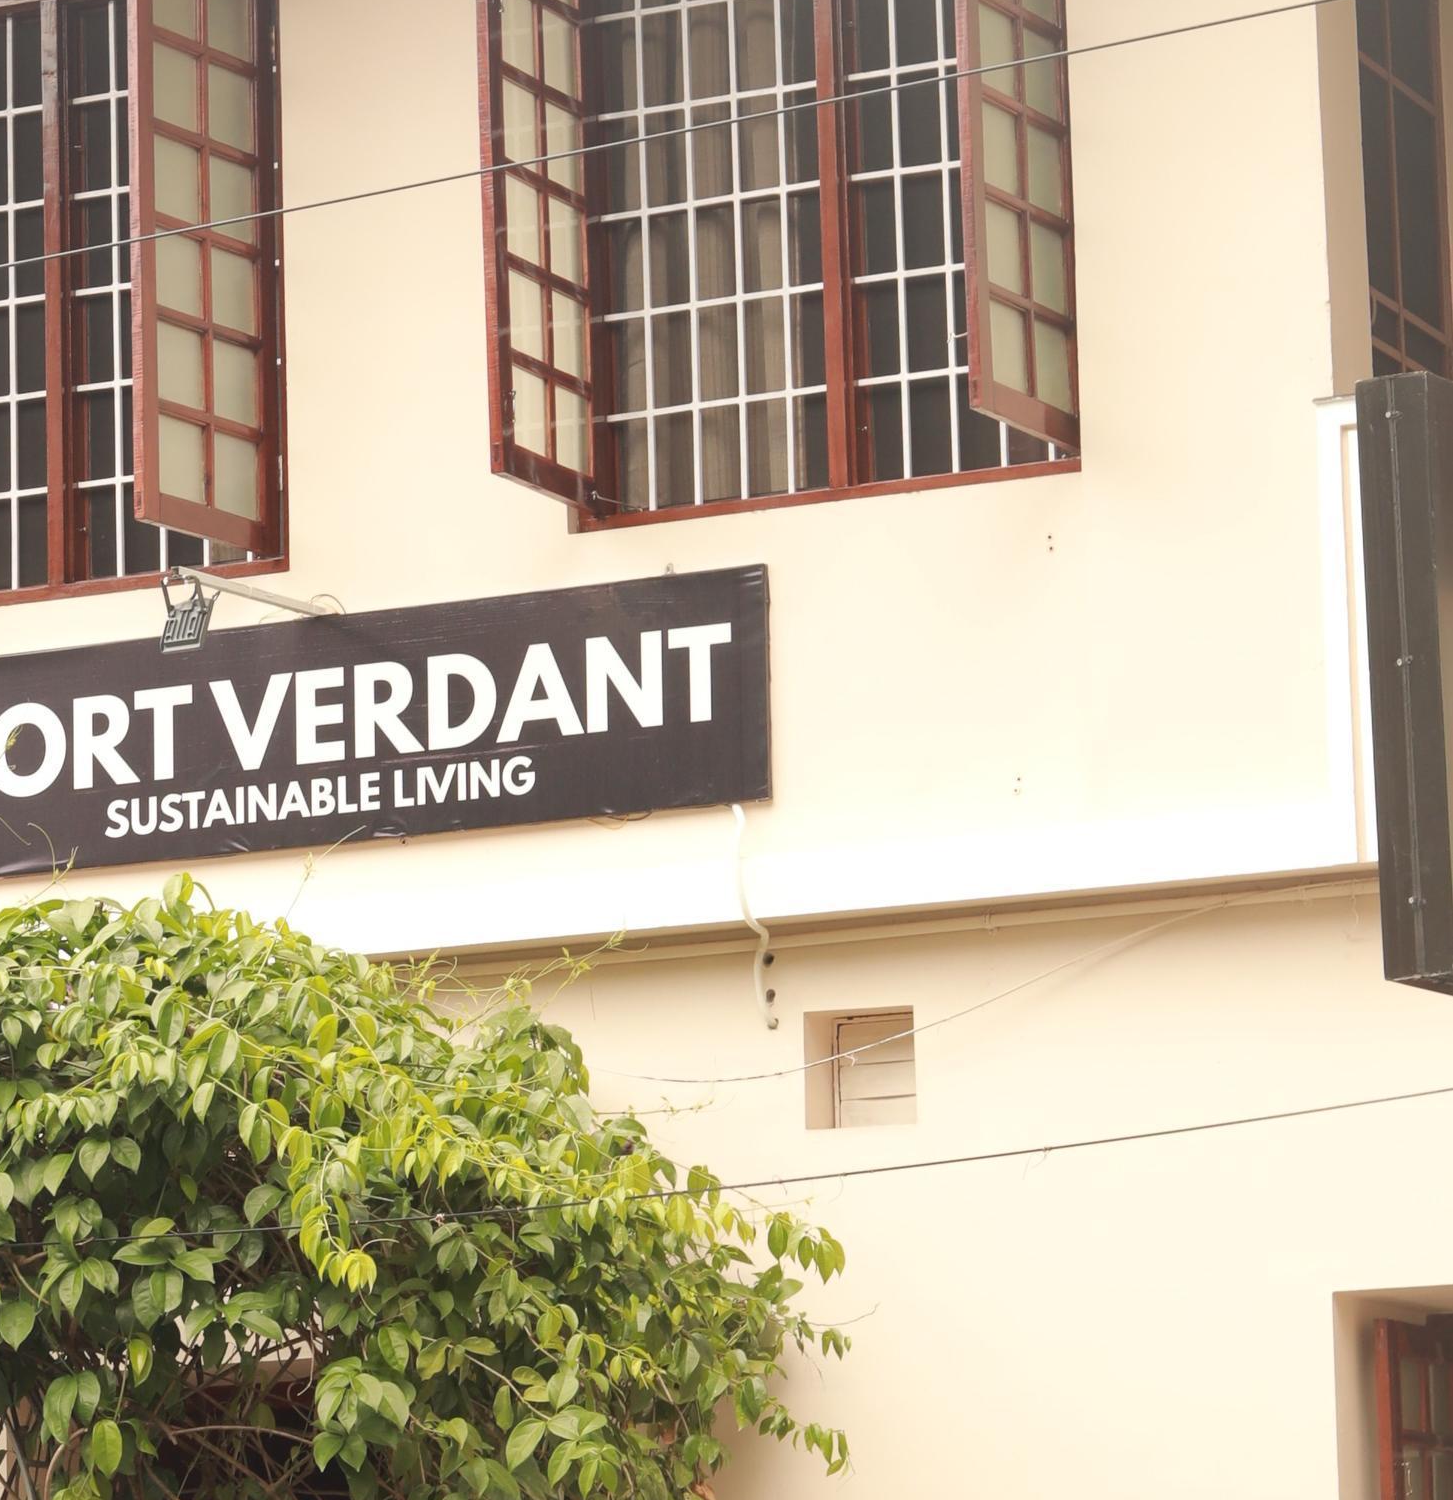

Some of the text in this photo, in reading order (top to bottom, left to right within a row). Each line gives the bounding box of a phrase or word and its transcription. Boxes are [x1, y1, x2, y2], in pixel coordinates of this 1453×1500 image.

[208, 621, 732, 771] VERDANT
[104, 755, 536, 839] SUSTAINABLE LIVING
